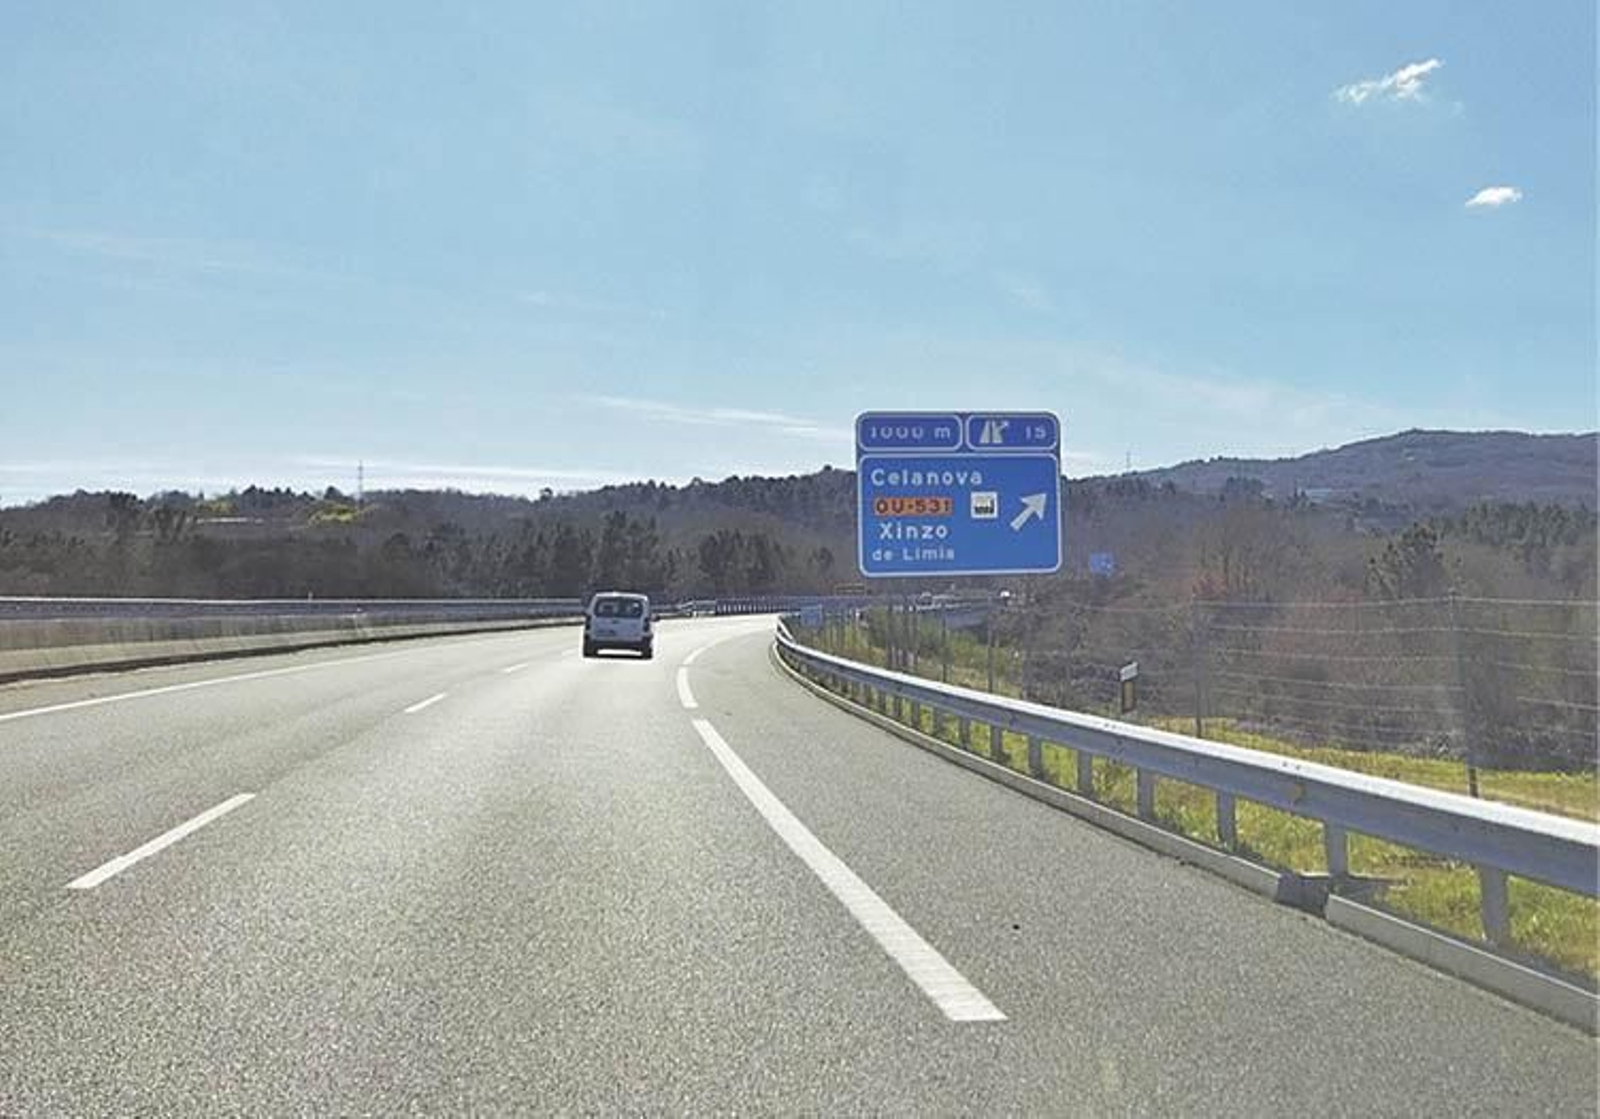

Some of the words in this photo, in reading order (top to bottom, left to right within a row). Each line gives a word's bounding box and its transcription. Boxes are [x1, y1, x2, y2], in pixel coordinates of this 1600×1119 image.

[870, 426, 924, 439] 1000
[934, 427, 951, 439] m
[870, 468, 982, 486] Celanova
[876, 499, 950, 514] OU-531
[879, 522, 948, 539] Xinzo
[872, 548, 893, 561] de
[903, 547, 955, 561] Limia
